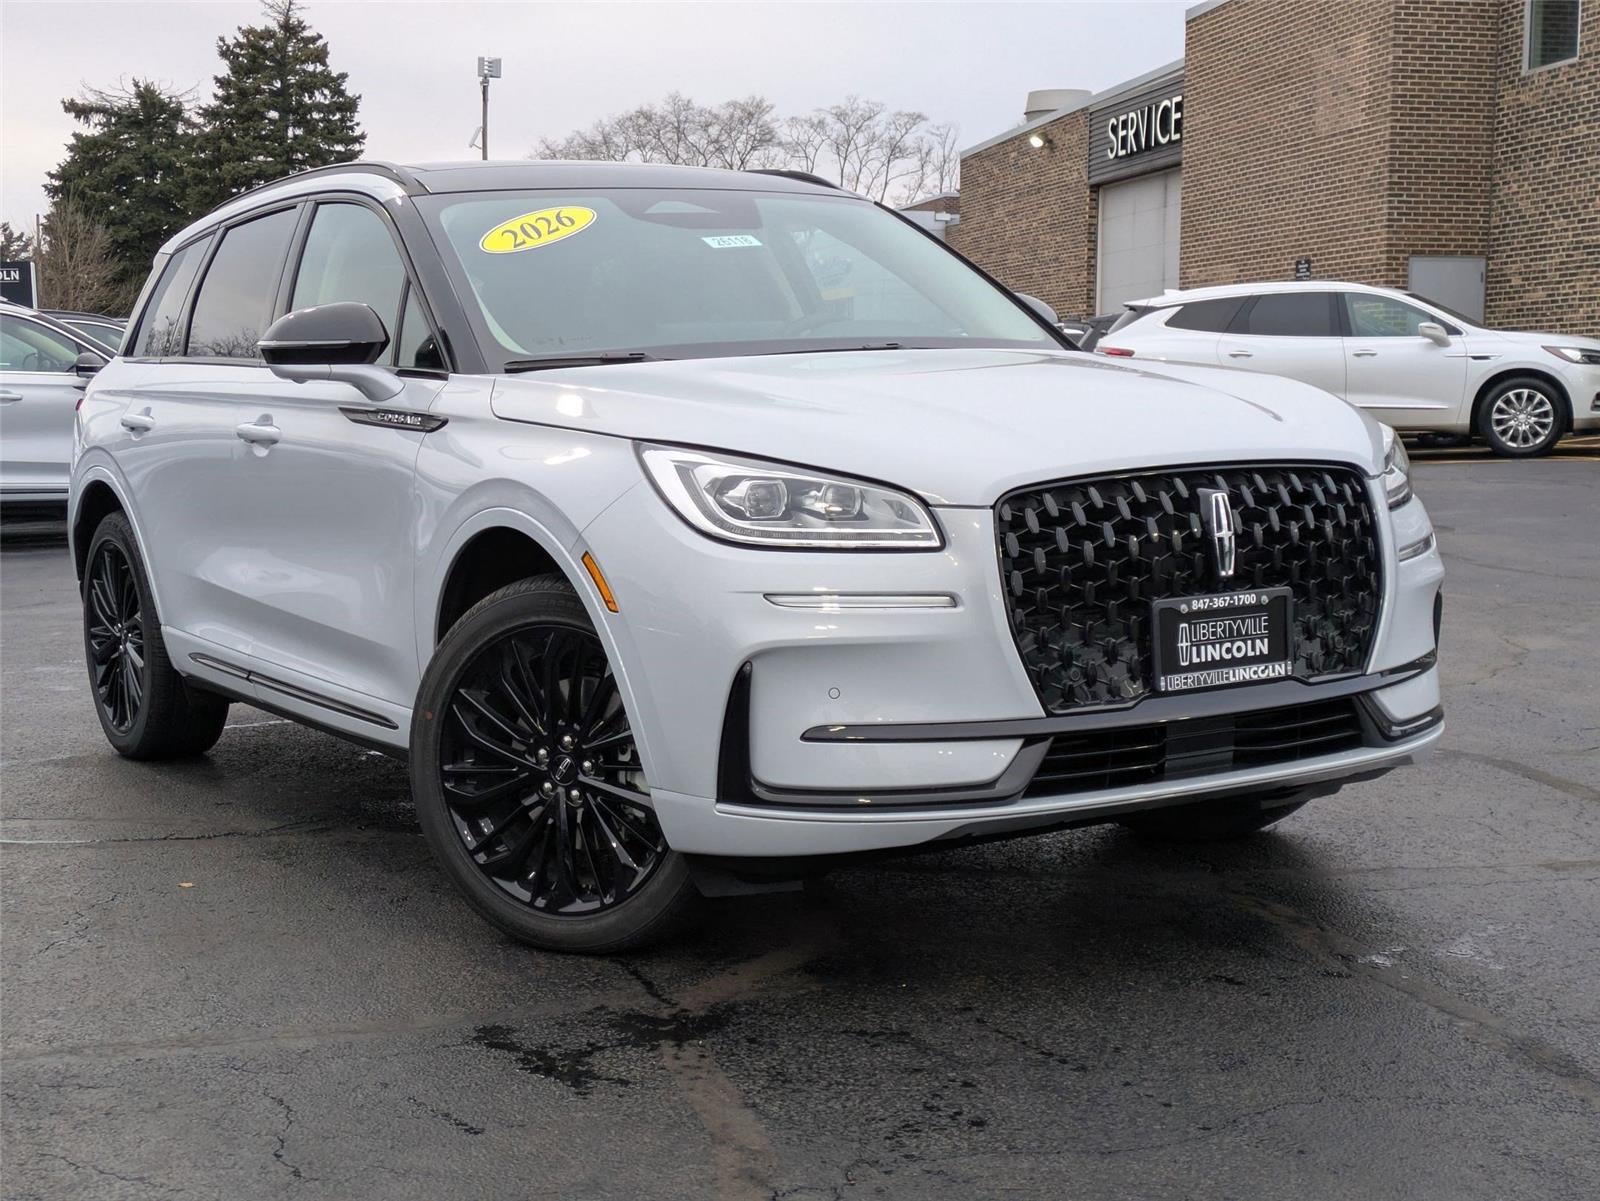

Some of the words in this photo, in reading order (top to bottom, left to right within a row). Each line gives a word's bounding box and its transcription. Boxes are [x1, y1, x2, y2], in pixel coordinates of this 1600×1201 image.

[1107, 95, 1182, 159] SERVICE
[501, 209, 575, 248] 2026
[377, 412, 421, 425] CORSAIR
[1192, 594, 1256, 610] 847-367-1700
[1191, 616, 1269, 641] LIBERTYVILLE
[1192, 638, 1269, 663] LINCOLN
